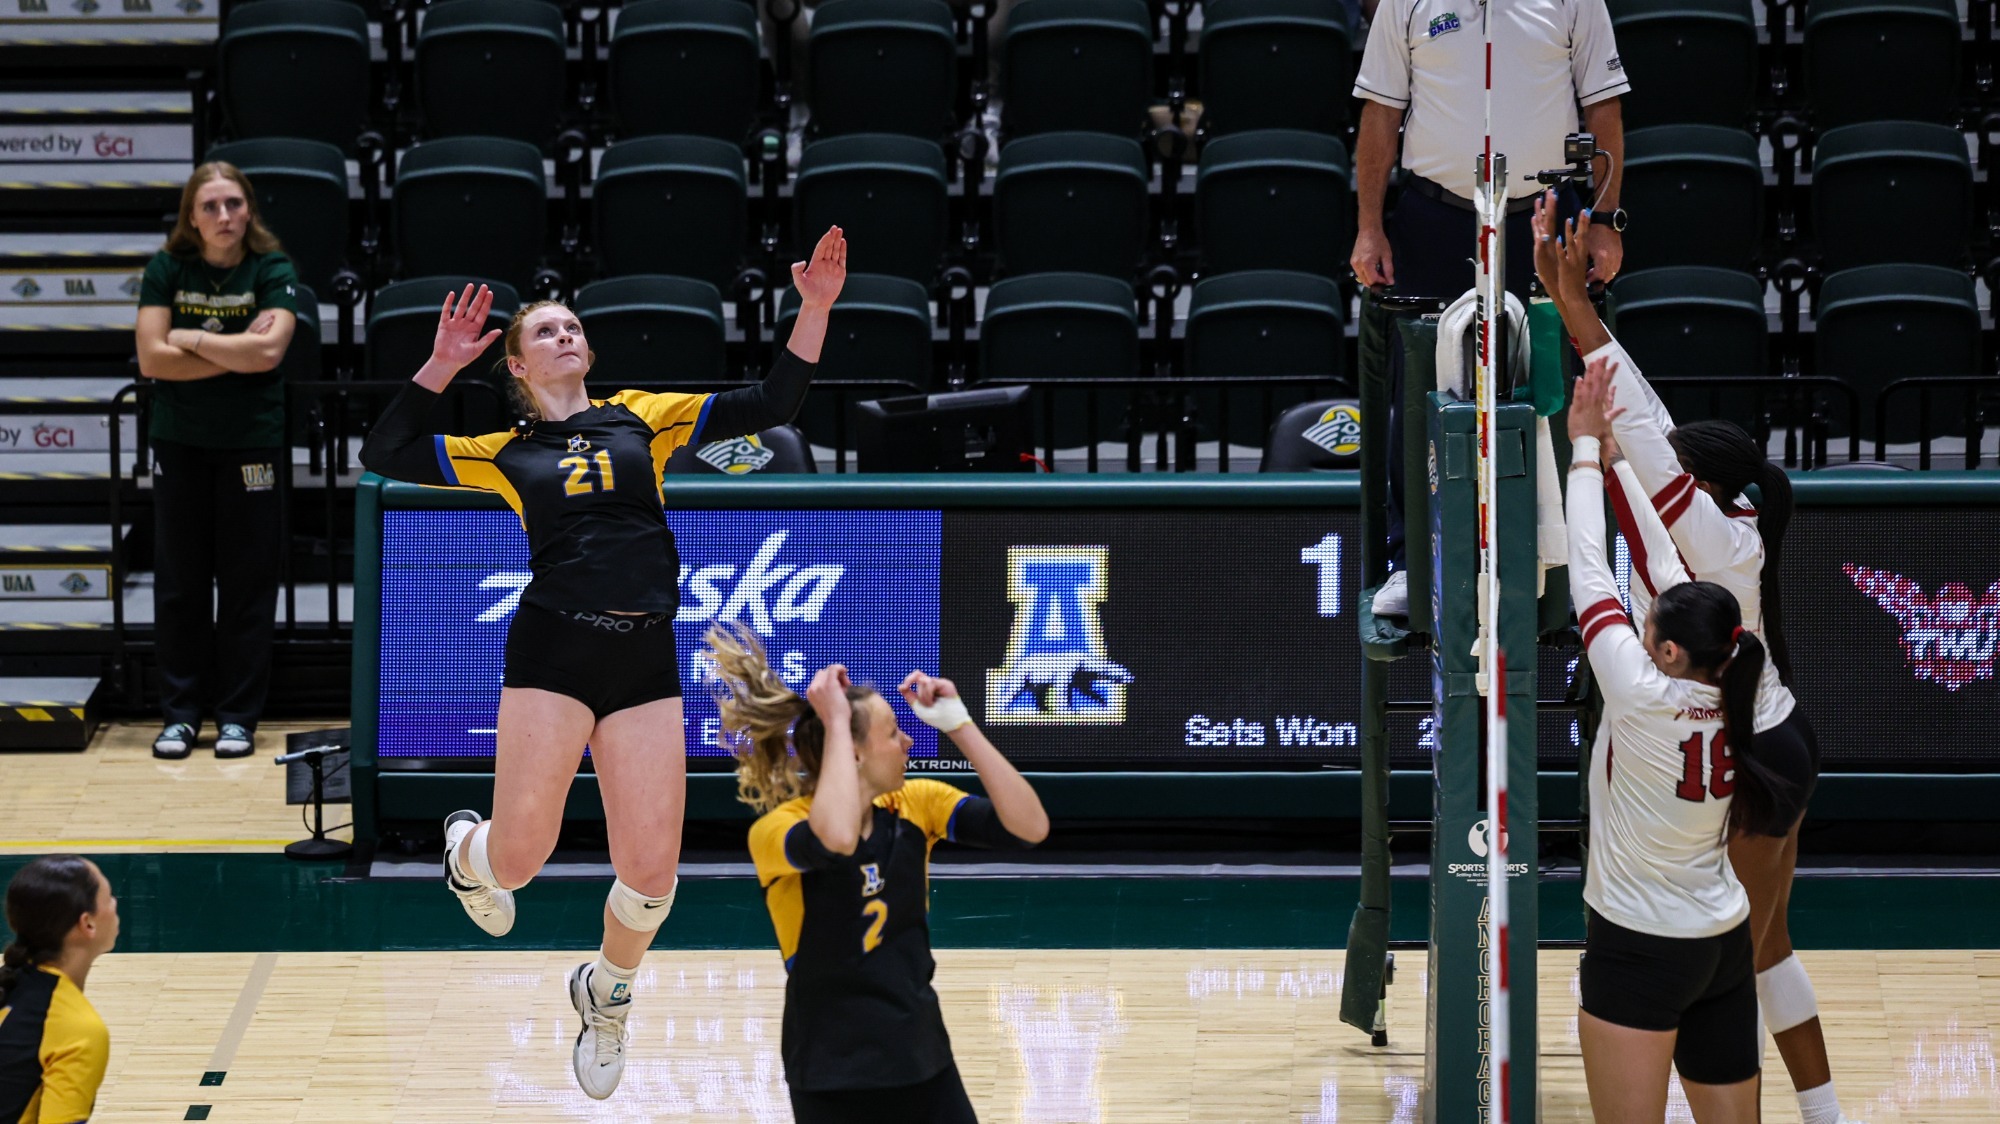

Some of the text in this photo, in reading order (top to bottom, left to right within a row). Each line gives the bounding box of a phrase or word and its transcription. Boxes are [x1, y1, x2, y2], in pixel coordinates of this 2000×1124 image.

[1429, 18, 1460, 37] GNAC
[59, 136, 82, 155] by
[95, 136, 133, 157] GCI
[64, 279, 96, 296] UAA
[34, 427, 74, 447] GCI
[241, 463, 275, 487] UAA
[557, 448, 615, 498] 21
[2, 574, 36, 592] UAA
[1301, 532, 1342, 618] 1
[574, 611, 634, 632] PRO
[985, 544, 1134, 726] A
[1184, 714, 1265, 746] Sets
[1275, 714, 1357, 746] Won
[1448, 863, 1528, 874] SPORTS IORTS
[862, 899, 888, 953] 2
